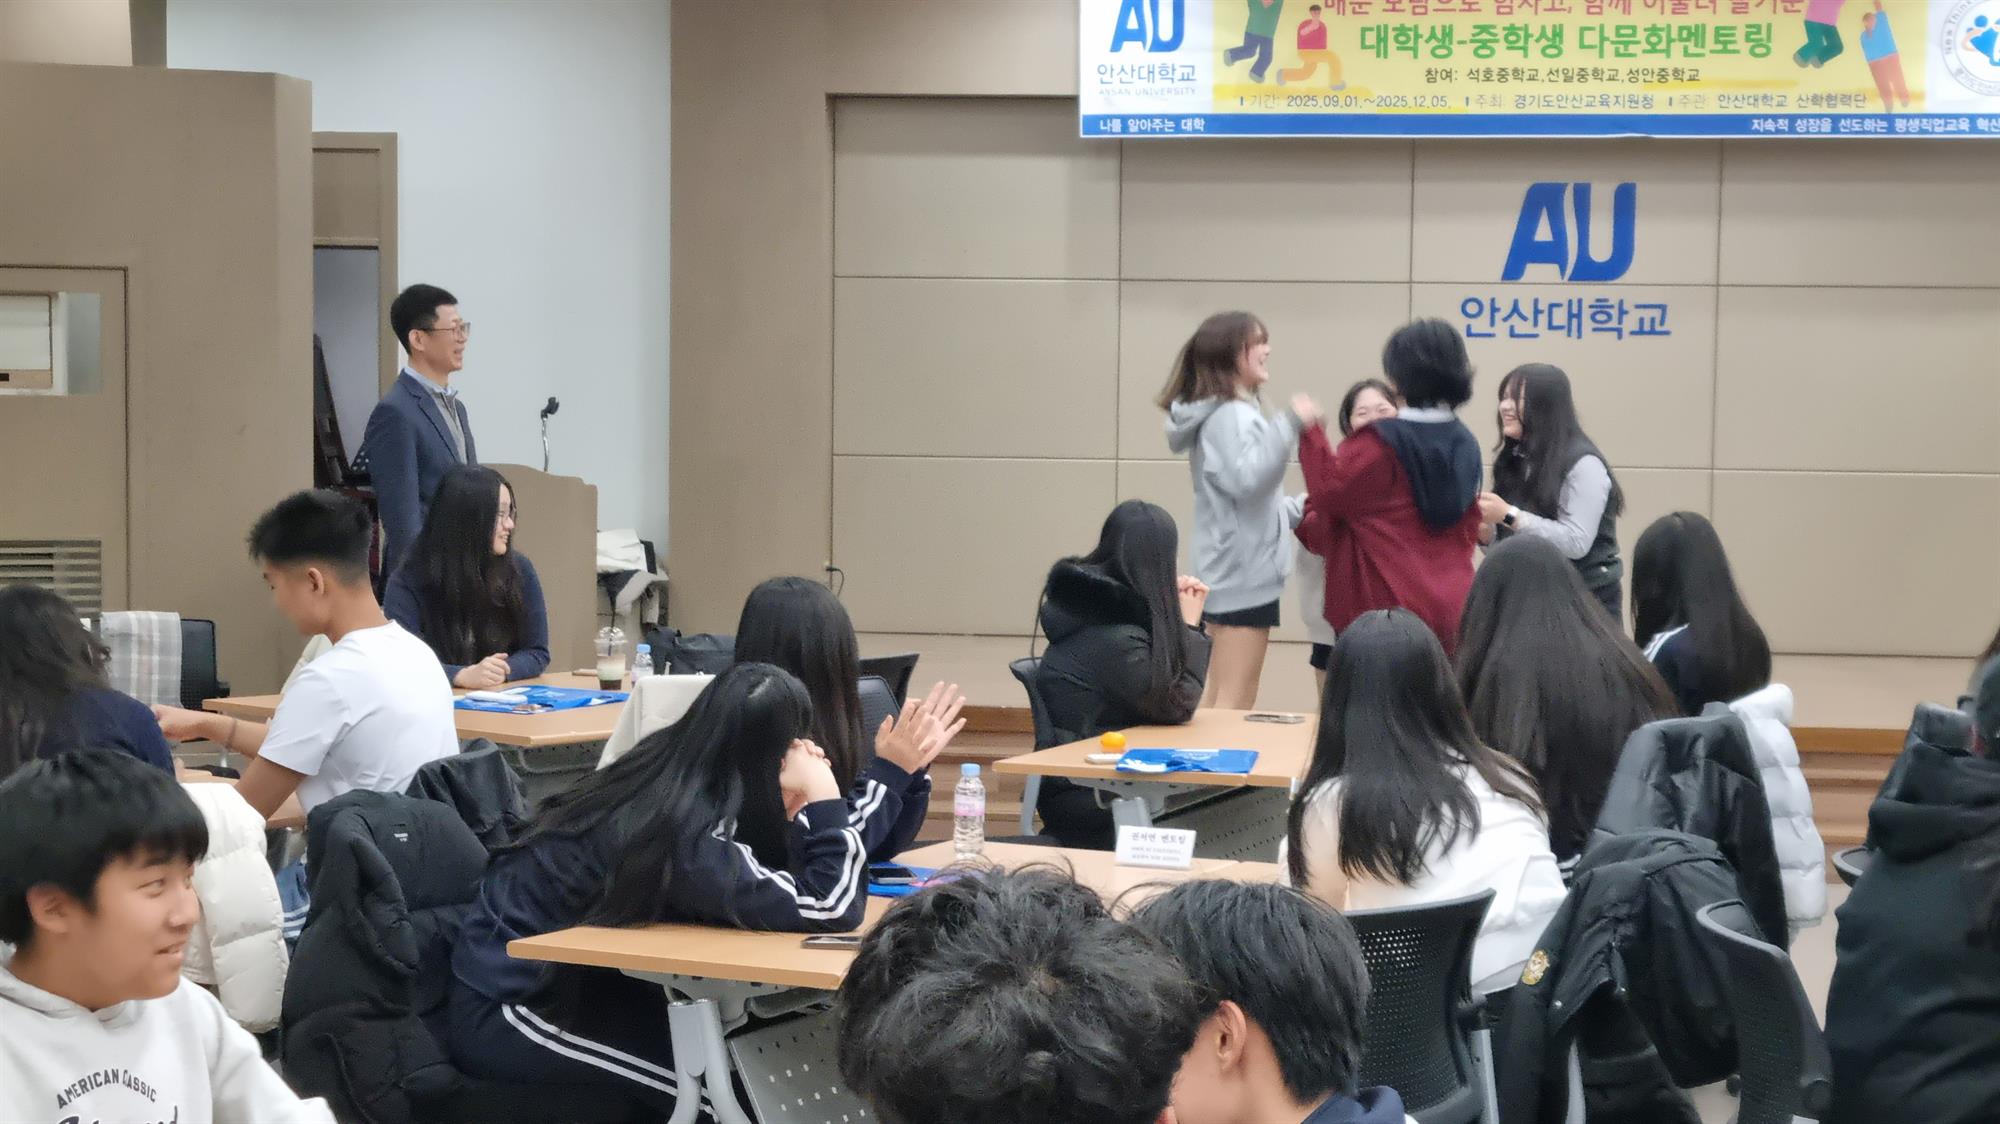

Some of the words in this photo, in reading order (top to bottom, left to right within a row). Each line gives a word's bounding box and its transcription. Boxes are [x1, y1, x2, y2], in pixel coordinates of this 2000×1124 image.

[1110, 0, 1185, 53] AU
[1360, 23, 1565, 59] 대학생-중학생
[1578, 22, 1774, 59] 다문화멘토링
[1096, 62, 1197, 84] 안산대학교
[1424, 67, 1458, 83] 참여:
[1466, 67, 1702, 84] 석호중학교,선일중학교,성안중학교
[1098, 86, 1131, 96] ANSAN
[1135, 86, 1196, 96] UNIVERSITY
[1514, 94, 1656, 109] 경기도안산교육지원청
[1717, 93, 1788, 109] 안산대학교
[1796, 93, 1867, 109] 산학협력단
[1100, 118, 1122, 133] 나를
[1127, 118, 1176, 133] 알아주는
[1181, 117, 1206, 132] 대학
[1751, 117, 1789, 132] 지속적
[1795, 117, 1832, 131] 성장을
[1838, 117, 1888, 131] 선도하는
[1894, 117, 1970, 132] 평생직업교육
[1501, 182, 1637, 282] AU
[1460, 296, 1673, 341] 안산대학교
[56, 1067, 120, 1110] AMERICAN
